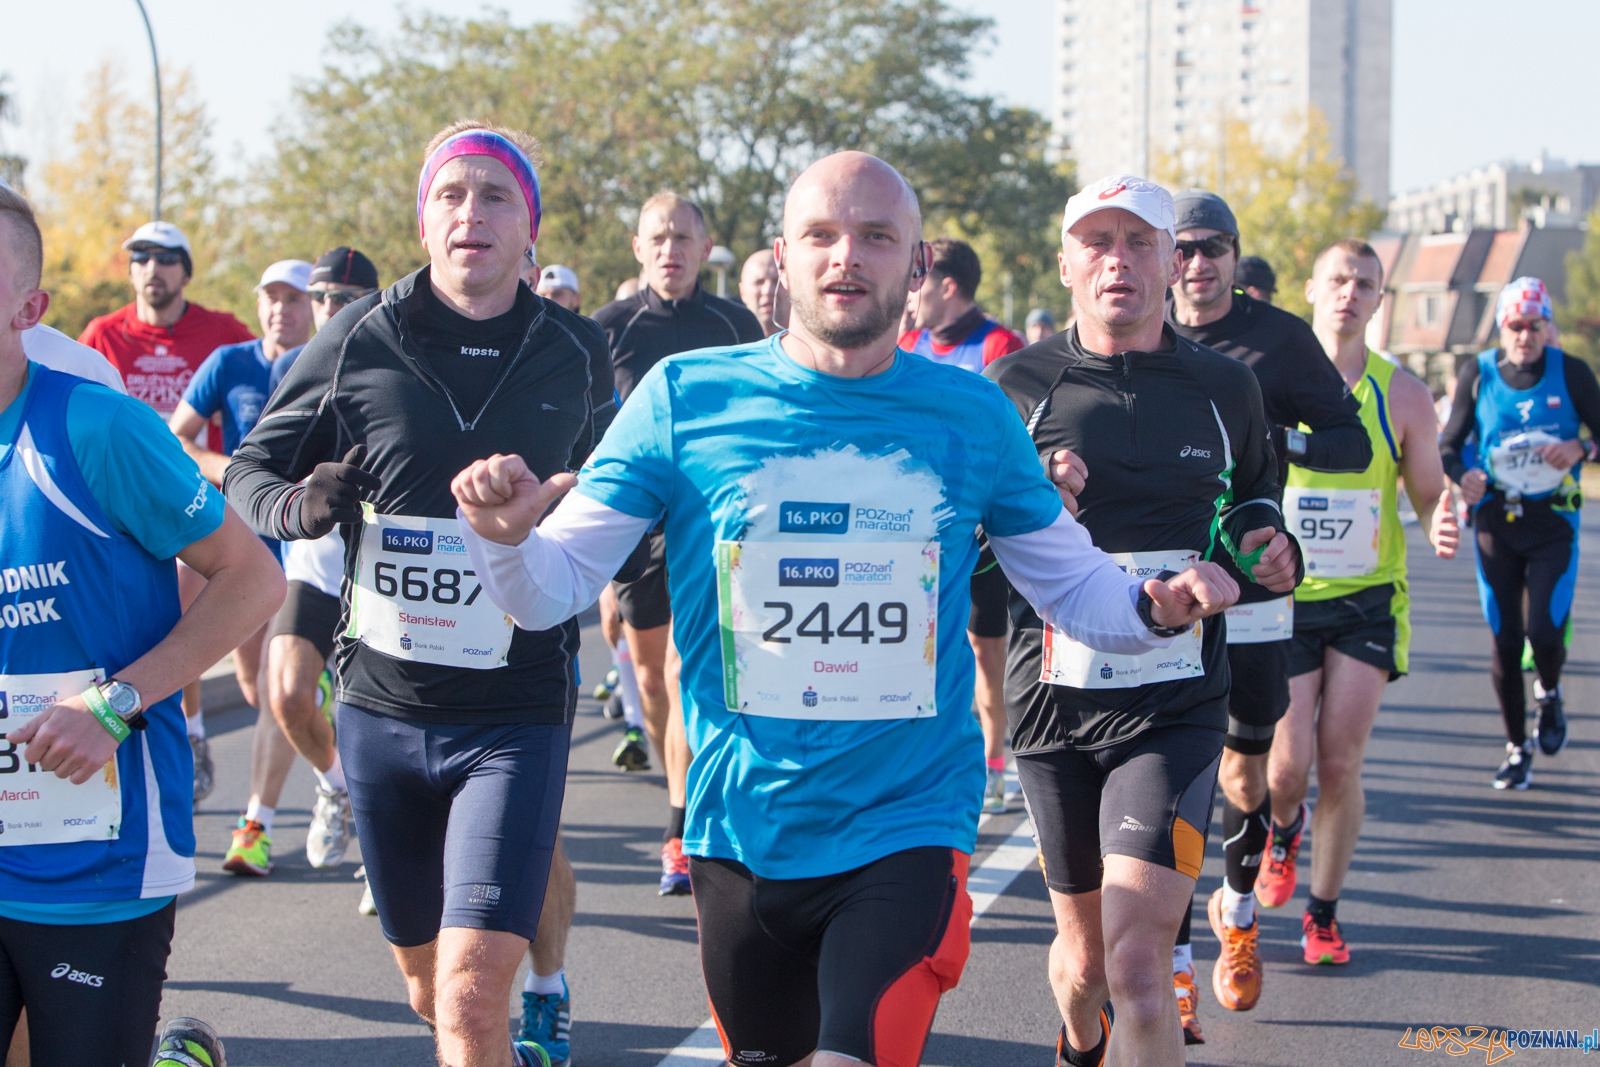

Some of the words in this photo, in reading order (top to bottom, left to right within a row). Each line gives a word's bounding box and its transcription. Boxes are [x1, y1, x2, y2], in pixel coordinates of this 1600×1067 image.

[461, 346, 500, 357] kipsta
[1191, 448, 1212, 459] asics
[785, 511, 807, 525] 16.
[810, 511, 844, 525] PKO
[855, 519, 910, 533] maraton
[1301, 518, 1353, 541] 957
[386, 535, 402, 546] 16.
[403, 536, 429, 548] PKO
[437, 544, 467, 553] marat
[783, 566, 803, 579] 16.
[805, 566, 835, 579] PKO
[844, 572, 892, 582] maraton
[374, 561, 484, 606] 6687
[398, 612, 457, 628] Stanisław
[762, 601, 908, 645] 2449
[813, 660, 859, 674] Dawid
[104, 716, 123, 735] STOP
[24, 821, 42, 829] Polski
[468, 897, 499, 906] karrimor
[67, 969, 105, 988] asics
